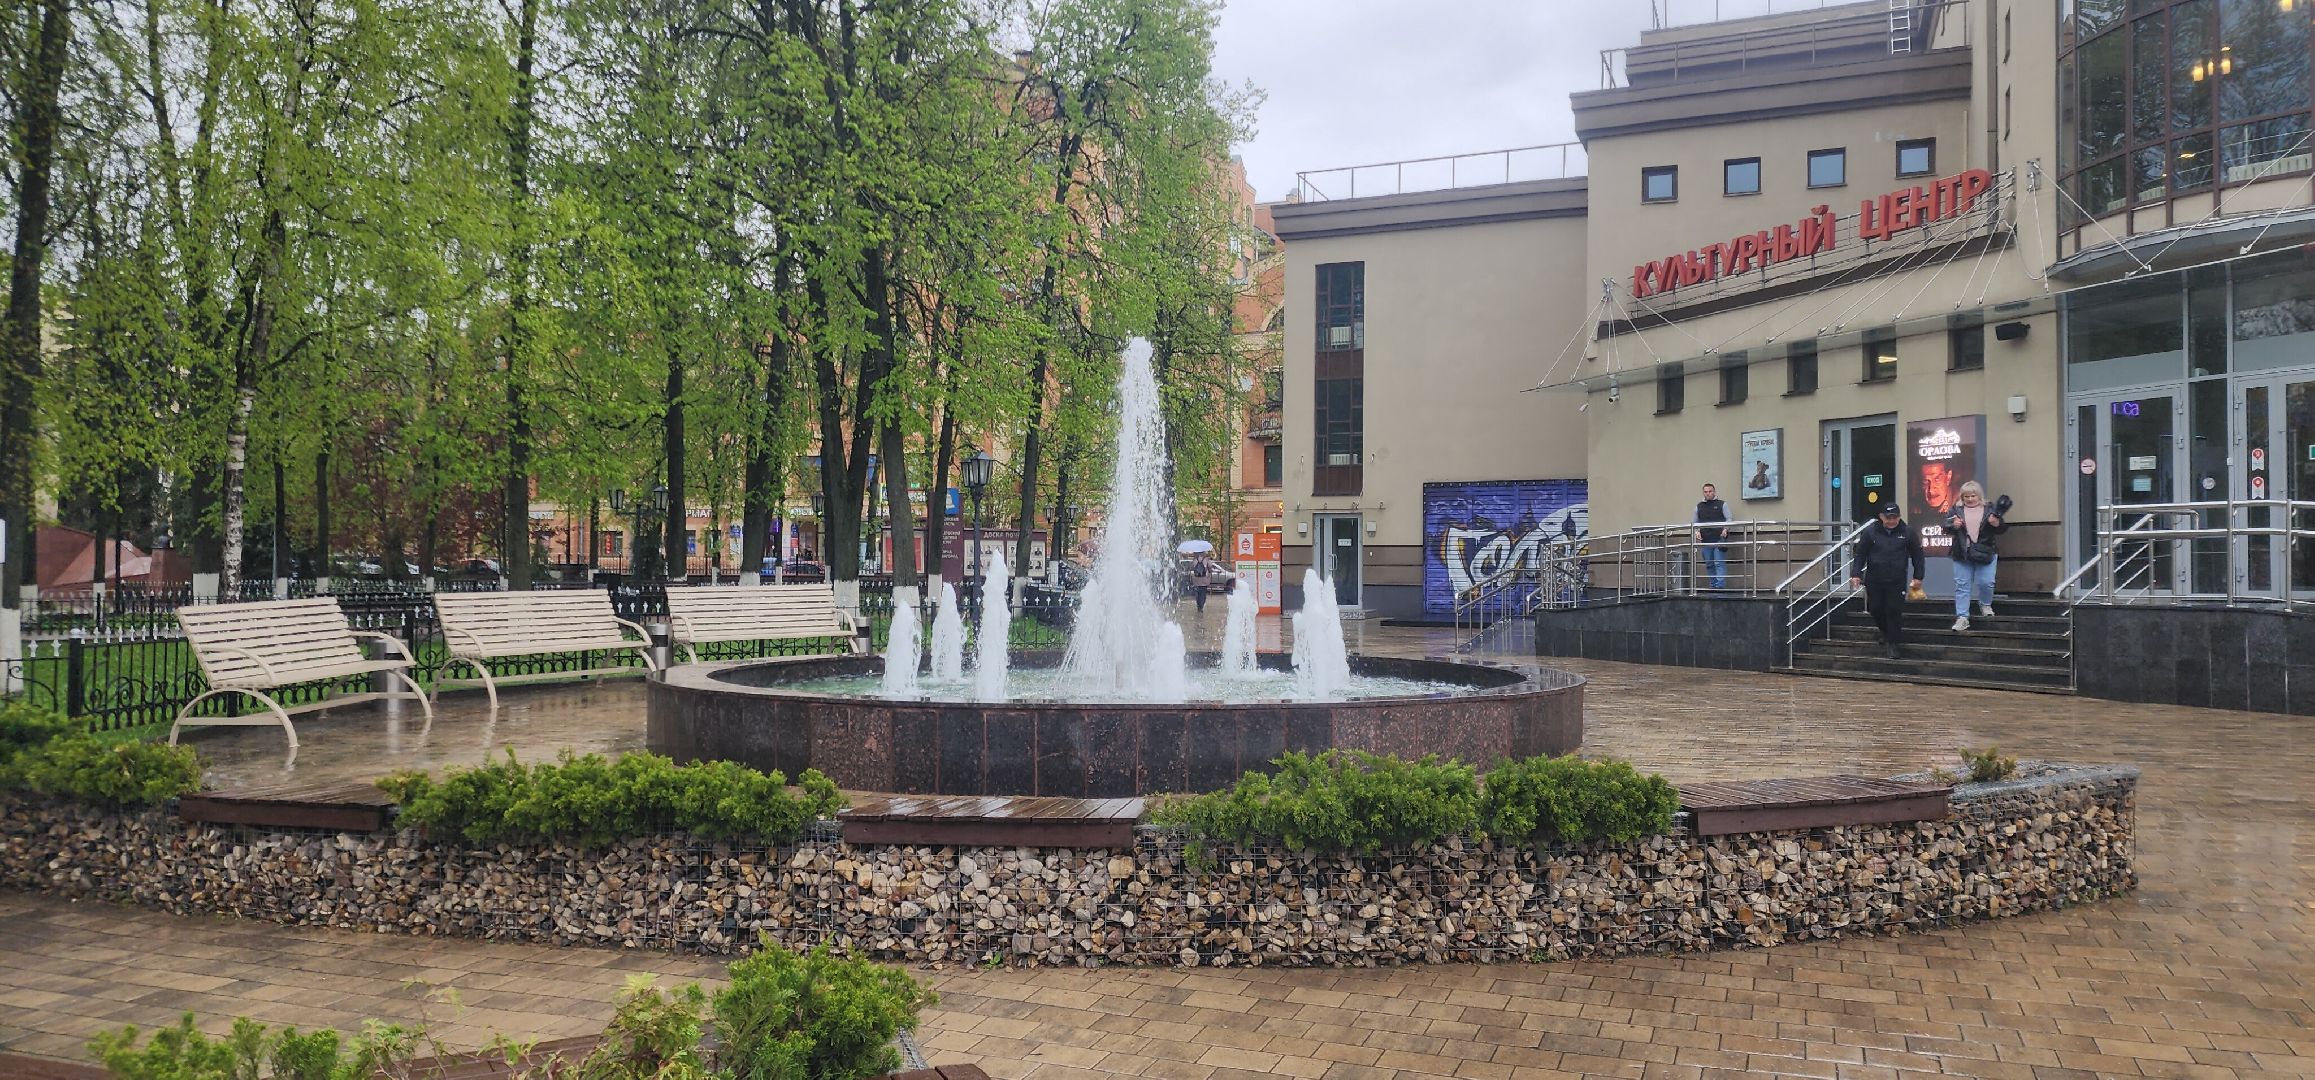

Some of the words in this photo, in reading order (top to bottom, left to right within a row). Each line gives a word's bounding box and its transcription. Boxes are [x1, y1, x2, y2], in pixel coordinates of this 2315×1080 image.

[1633, 205, 1836, 298] КУЛЬТУРНЫЙ
[1860, 168, 1992, 241] ЦЕНТР
[1918, 444, 1962, 457] ОРЛОВА
[983, 531, 1004, 539] ДОСКА
[1921, 525, 1946, 536] СЕЙ
[1922, 537, 1929, 547] В
[1930, 536, 1953, 547] КИН
